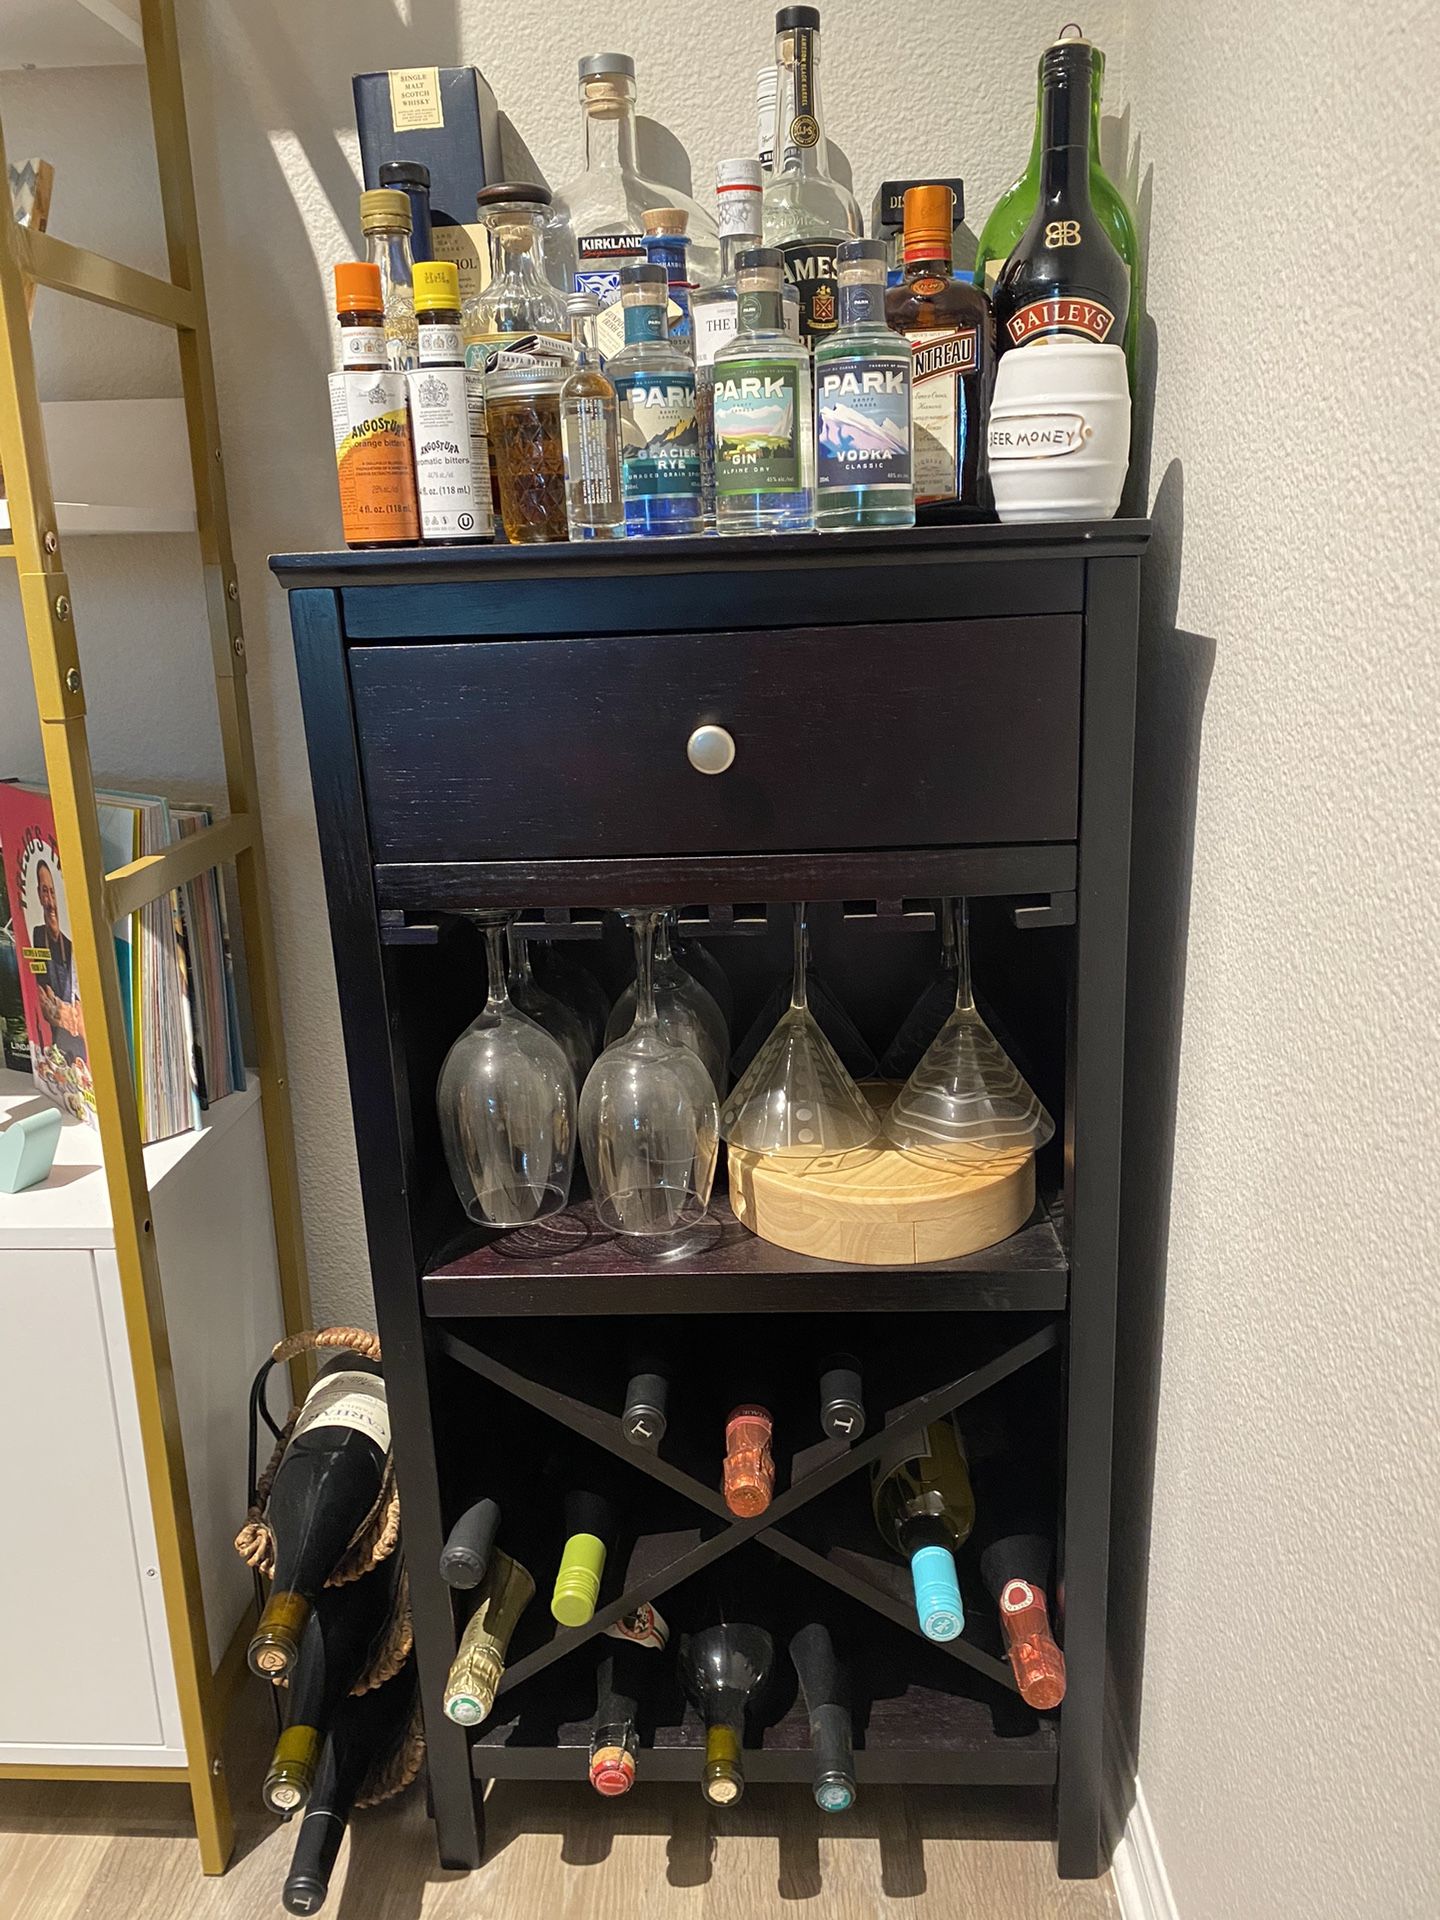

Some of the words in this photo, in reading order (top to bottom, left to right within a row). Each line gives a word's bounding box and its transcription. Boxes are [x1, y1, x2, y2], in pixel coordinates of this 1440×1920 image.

[400, 74, 427, 82] SINGLE
[401, 90, 430, 98] SCOTCH
[402, 98, 430, 106] WHISKY
[706, 318, 730, 332] THE
[1012, 303, 1107, 337] BAILEYS
[913, 338, 971, 377] NTREAU
[714, 377, 785, 402] PARK
[824, 371, 903, 398] PARK
[626, 385, 697, 409] PARK
[351, 417, 407, 439] ANGOSTURA
[353, 440, 382, 449] orange
[1016, 430, 1075, 446] MONEY
[420, 440, 460, 456] ANGOSTURA
[638, 448, 697, 460] GLACIER
[444, 456, 470, 465] bitters
[731, 453, 758, 465] GIN
[837, 449, 893, 463] VODKA
[657, 459, 686, 470] RYE
[723, 467, 748, 475] ALPINE
[845, 462, 884, 470] CLASSIC
[631, 1420, 653, 1438] T
[833, 1416, 854, 1434] T
[292, 1897, 313, 1911] T
